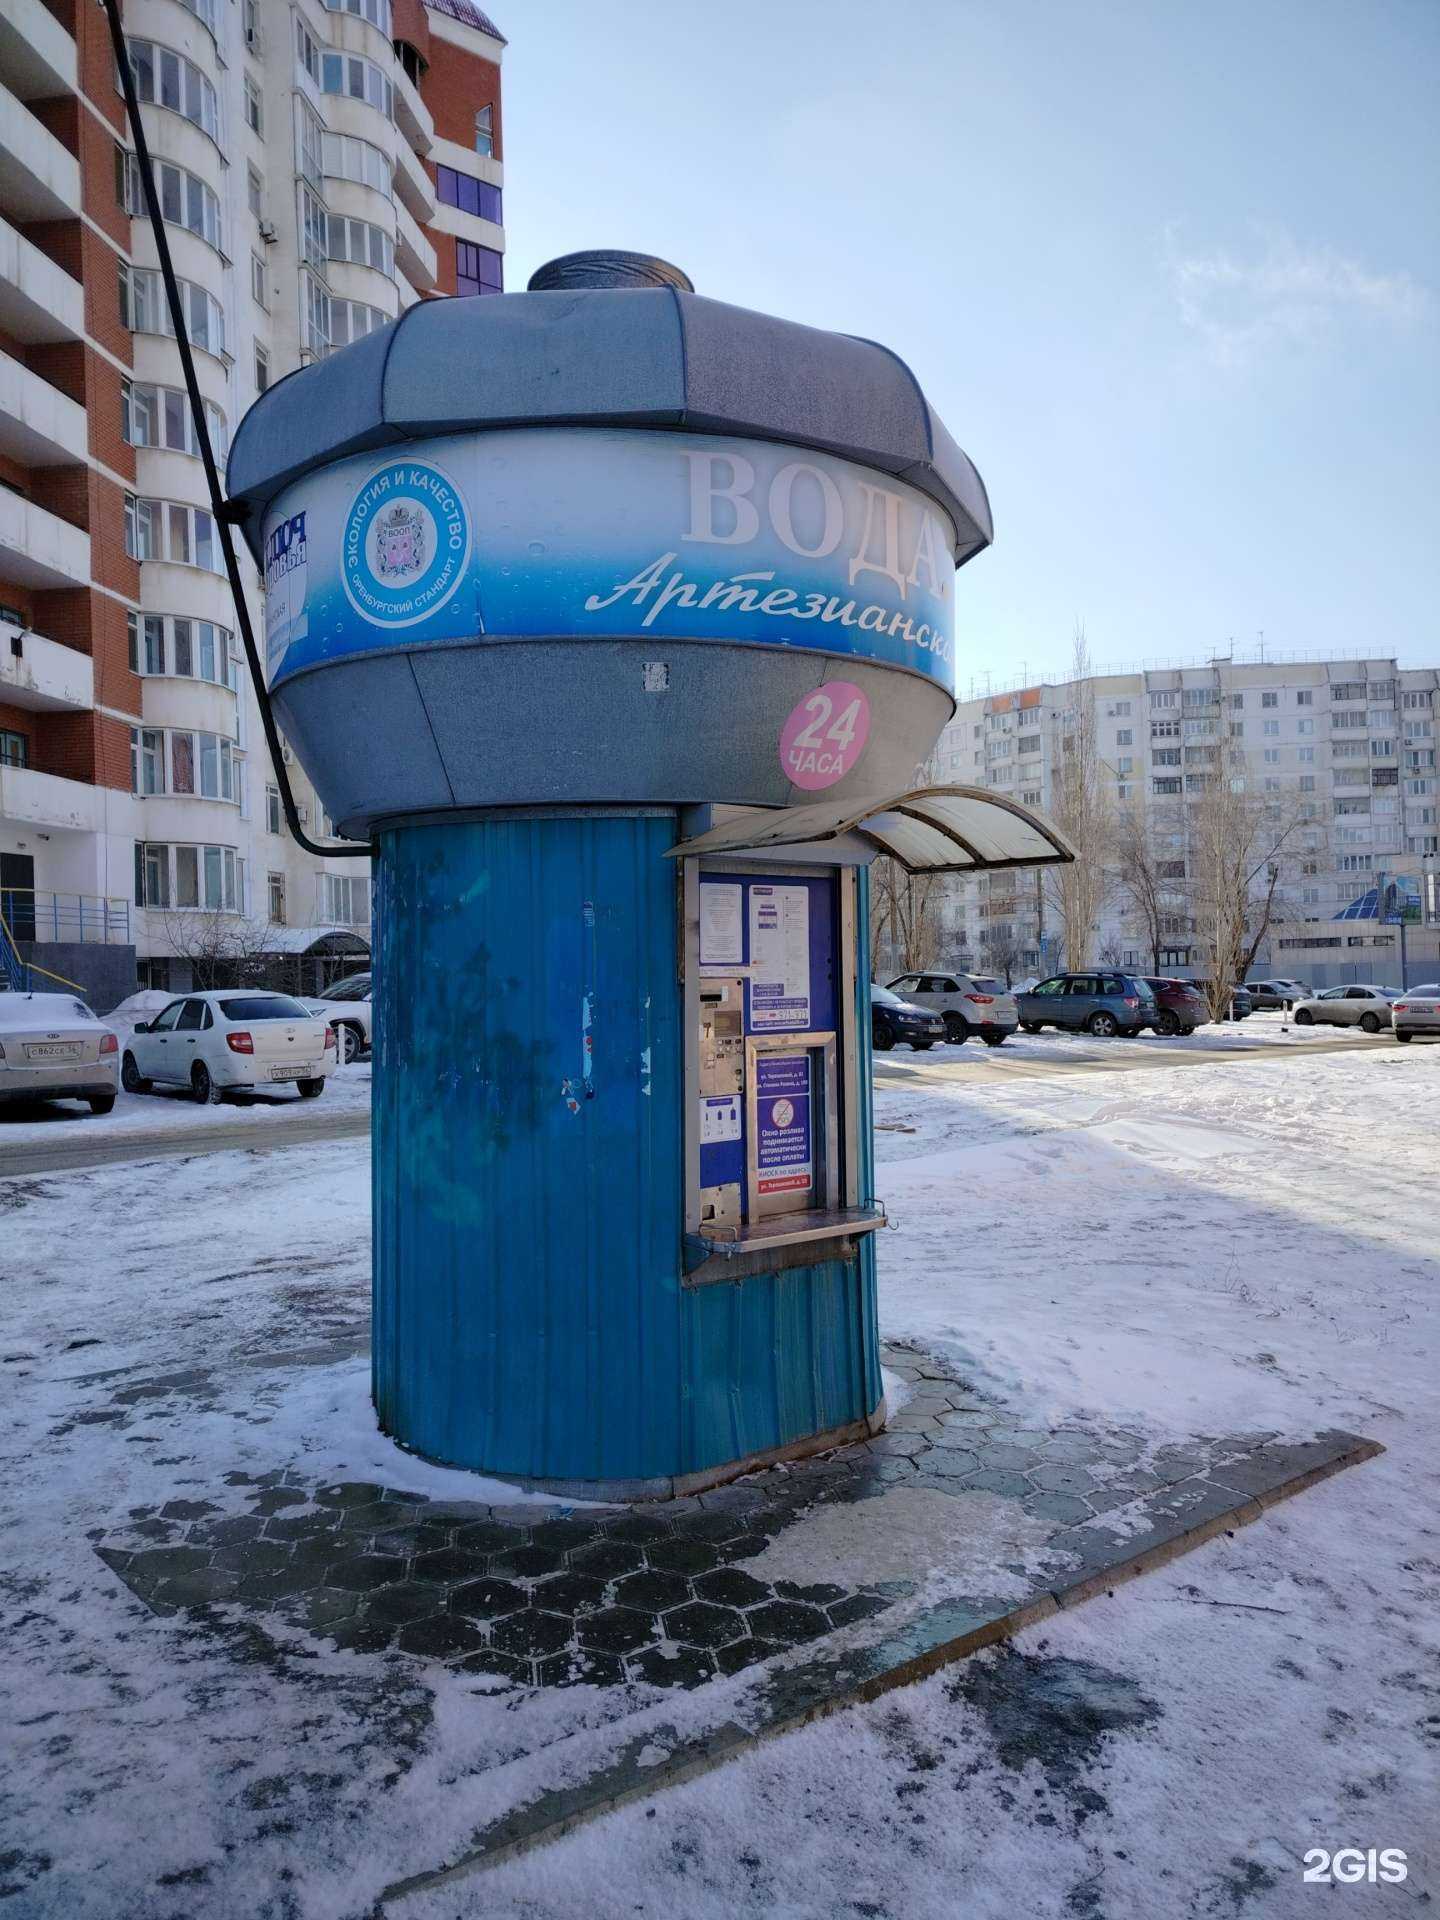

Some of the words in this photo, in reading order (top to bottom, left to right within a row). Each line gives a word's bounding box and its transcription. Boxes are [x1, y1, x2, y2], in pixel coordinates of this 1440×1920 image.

[348, 476, 391, 568] ЭКОЛОГИЯ
[394, 471, 405, 486] И
[410, 470, 463, 550] КАЧЕСТВО
[680, 450, 946, 601] ВОДА
[352, 575, 414, 615] ОРЕНБУРГСКИЙ
[415, 557, 456, 608] СТАНДАРТ
[585, 552, 953, 664] Артезианска
[794, 694, 861, 751] 24
[788, 750, 845, 775] ЧАСА
